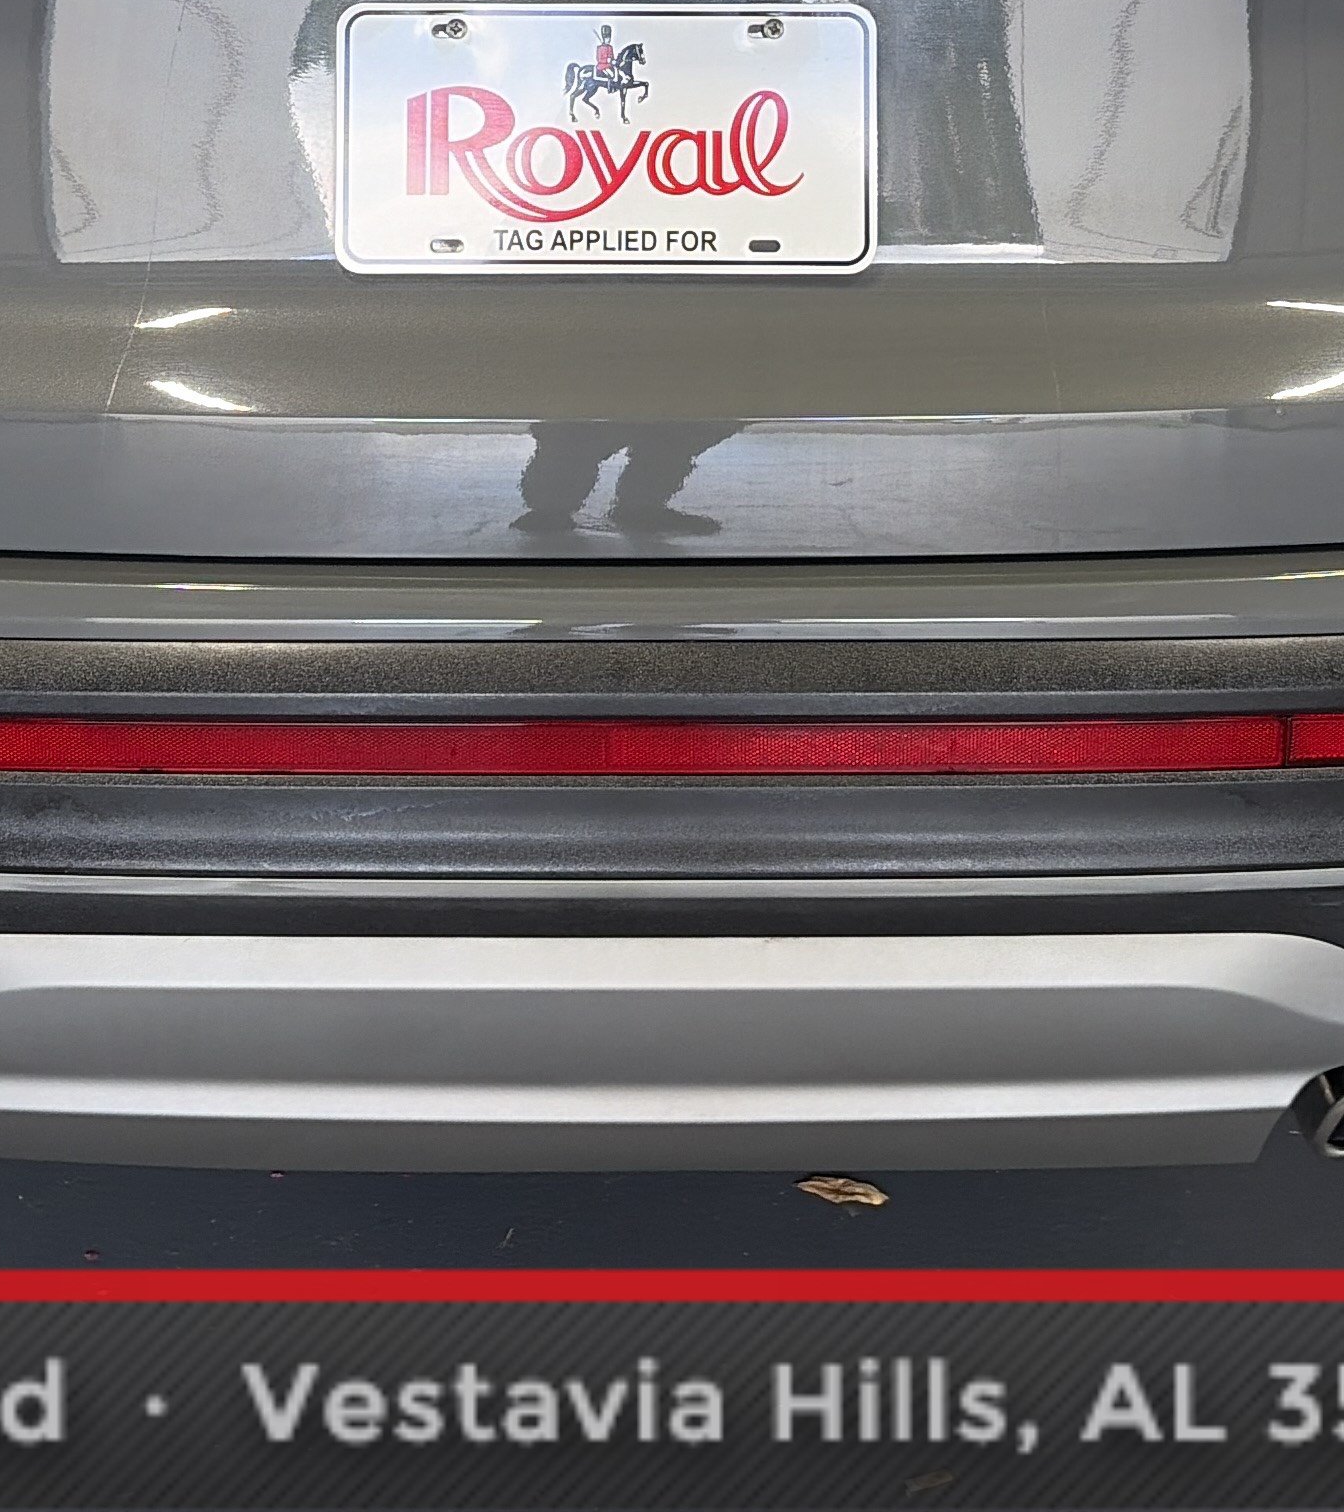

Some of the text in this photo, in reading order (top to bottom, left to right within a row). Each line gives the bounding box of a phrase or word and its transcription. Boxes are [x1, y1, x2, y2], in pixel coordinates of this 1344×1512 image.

[406, 85, 805, 223] Royal
[493, 229, 718, 252] TAG APPLIED FOR
